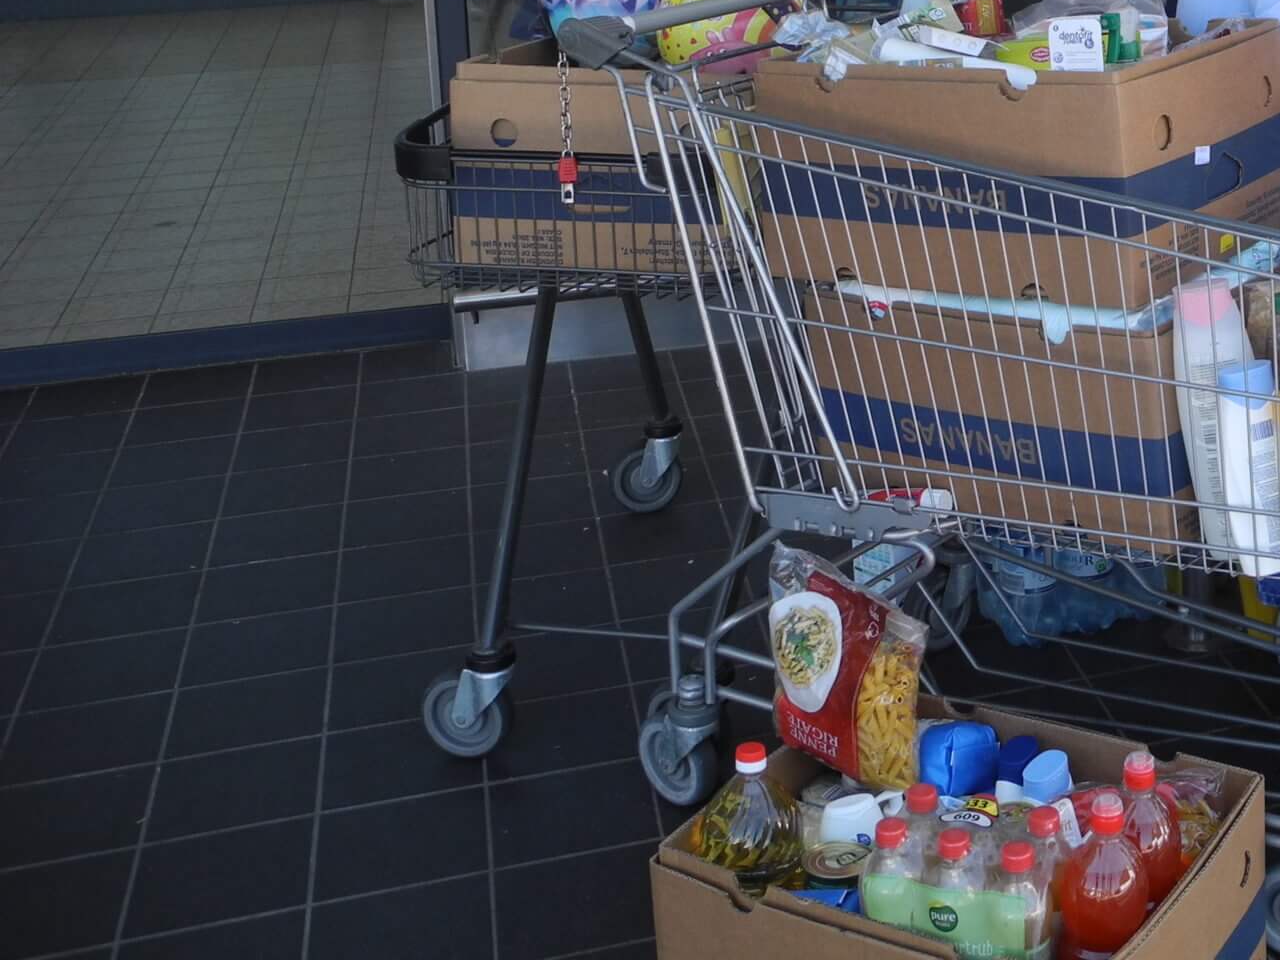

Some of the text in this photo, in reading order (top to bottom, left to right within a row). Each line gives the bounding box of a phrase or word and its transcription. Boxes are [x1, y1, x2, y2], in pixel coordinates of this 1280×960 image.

[862, 182, 1008, 216] BANANAS
[900, 417, 1039, 465] BANANAS
[786, 710, 839, 748] RIGATE
[790, 726, 838, 759] PENNE
[953, 810, 981, 822] 609
[930, 909, 957, 923] pure
